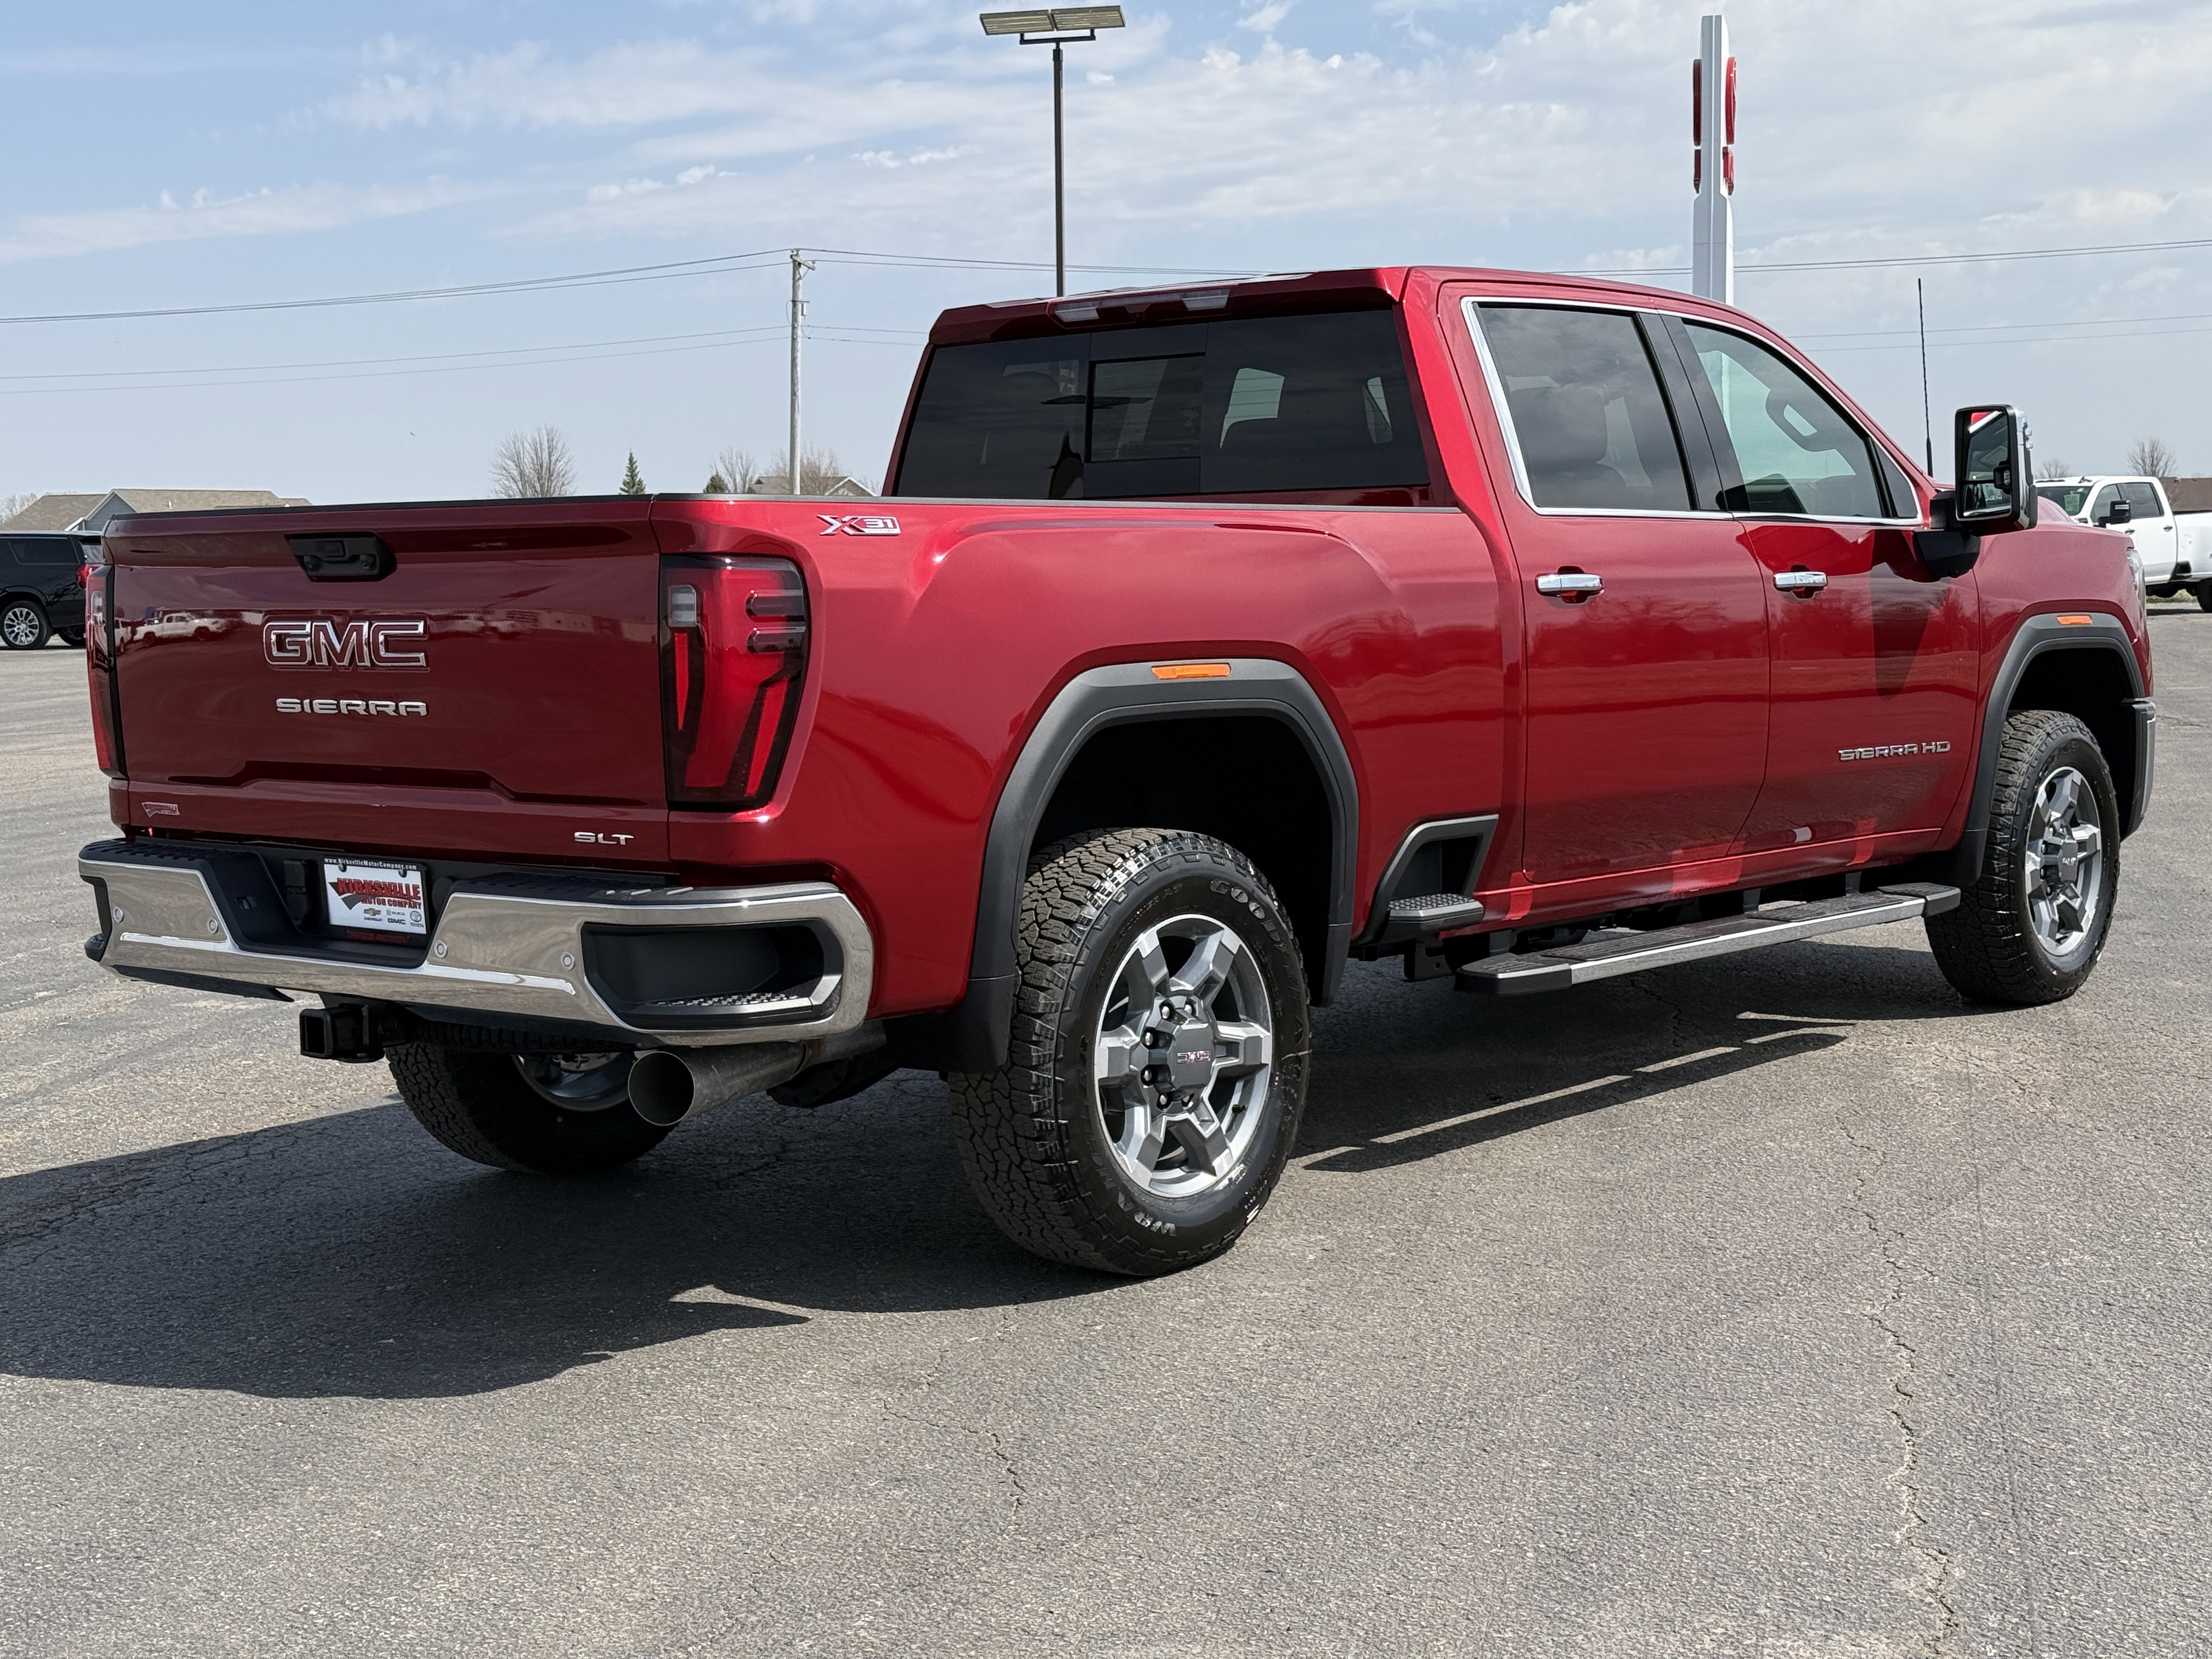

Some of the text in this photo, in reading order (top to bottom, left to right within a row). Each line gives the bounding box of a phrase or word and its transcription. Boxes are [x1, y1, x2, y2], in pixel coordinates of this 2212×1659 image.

[263, 620, 426, 667] GMC
[276, 698, 427, 716] SIERRA
[1838, 741, 1951, 761] SIERRA HD
[574, 832, 635, 845] SLT
[337, 878, 421, 900] KIRKSVILLE
[361, 897, 422, 910] MOTOR COMPANY
